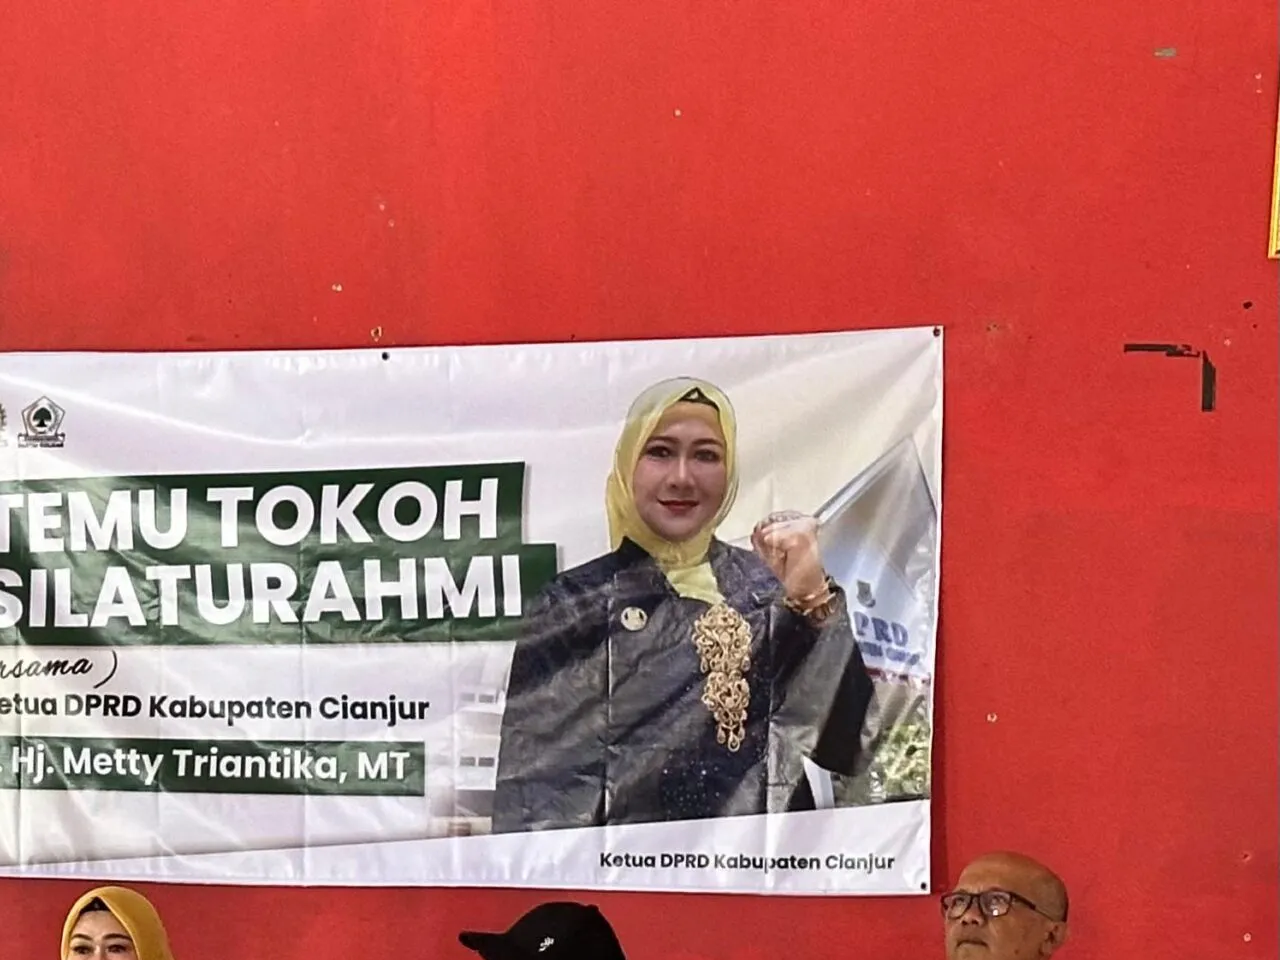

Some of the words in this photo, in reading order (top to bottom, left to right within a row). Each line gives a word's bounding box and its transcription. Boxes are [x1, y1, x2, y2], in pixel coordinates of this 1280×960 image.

[206, 478, 499, 549] TOKOH
[853, 611, 909, 647] PRD
[64, 694, 142, 718] DPRD
[149, 695, 312, 727] Kabupaten
[319, 694, 430, 727] Cianjur
[11, 744, 55, 784] Hj.
[63, 747, 164, 785] Metty
[172, 747, 348, 784] Triantika,
[357, 751, 411, 780] MT
[599, 852, 656, 869] Ketua
[660, 853, 710, 869] DPRD
[713, 853, 821, 874] Kabupaten
[825, 853, 895, 874] Cianjur
